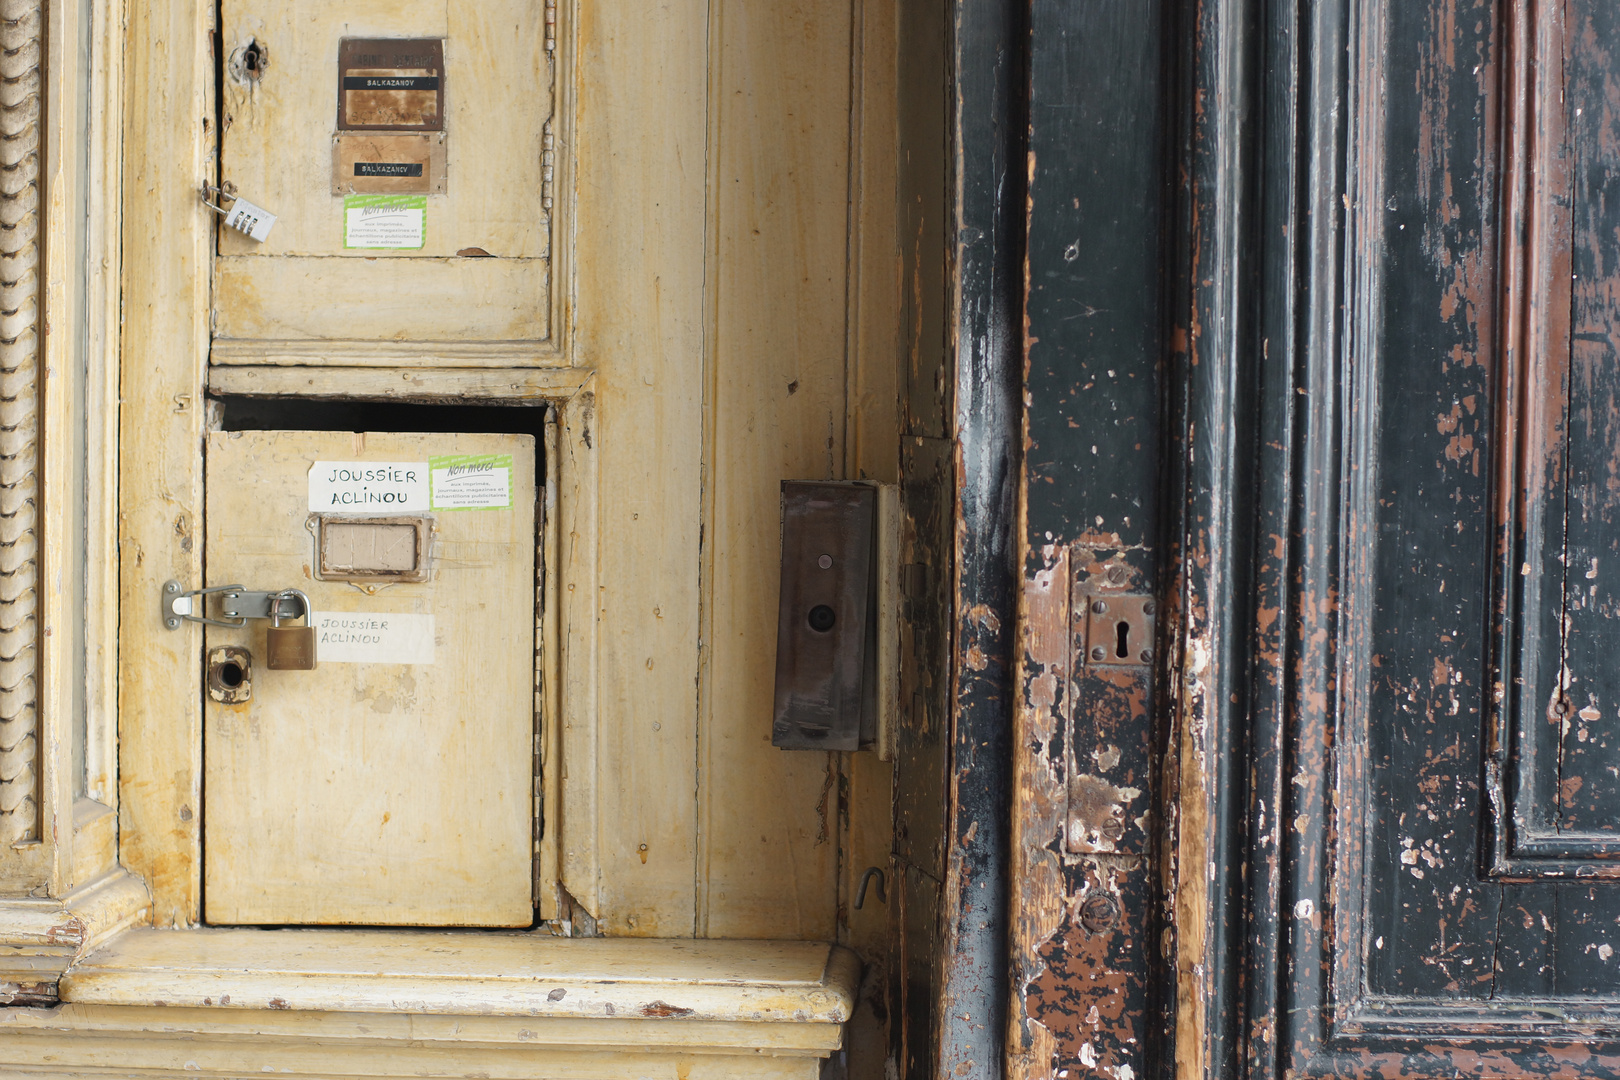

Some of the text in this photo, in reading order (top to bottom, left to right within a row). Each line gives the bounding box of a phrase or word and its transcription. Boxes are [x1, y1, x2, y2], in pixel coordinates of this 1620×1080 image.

[366, 79, 415, 87] SALKAZANOV
[361, 201, 409, 216] Non merci
[328, 466, 417, 483] JOUSSIER
[447, 463, 466, 477] Non
[467, 458, 497, 474] merci
[331, 486, 408, 505] ACLINOU
[321, 618, 389, 631] JOUSSIER
[321, 630, 381, 644] ACLINOU
